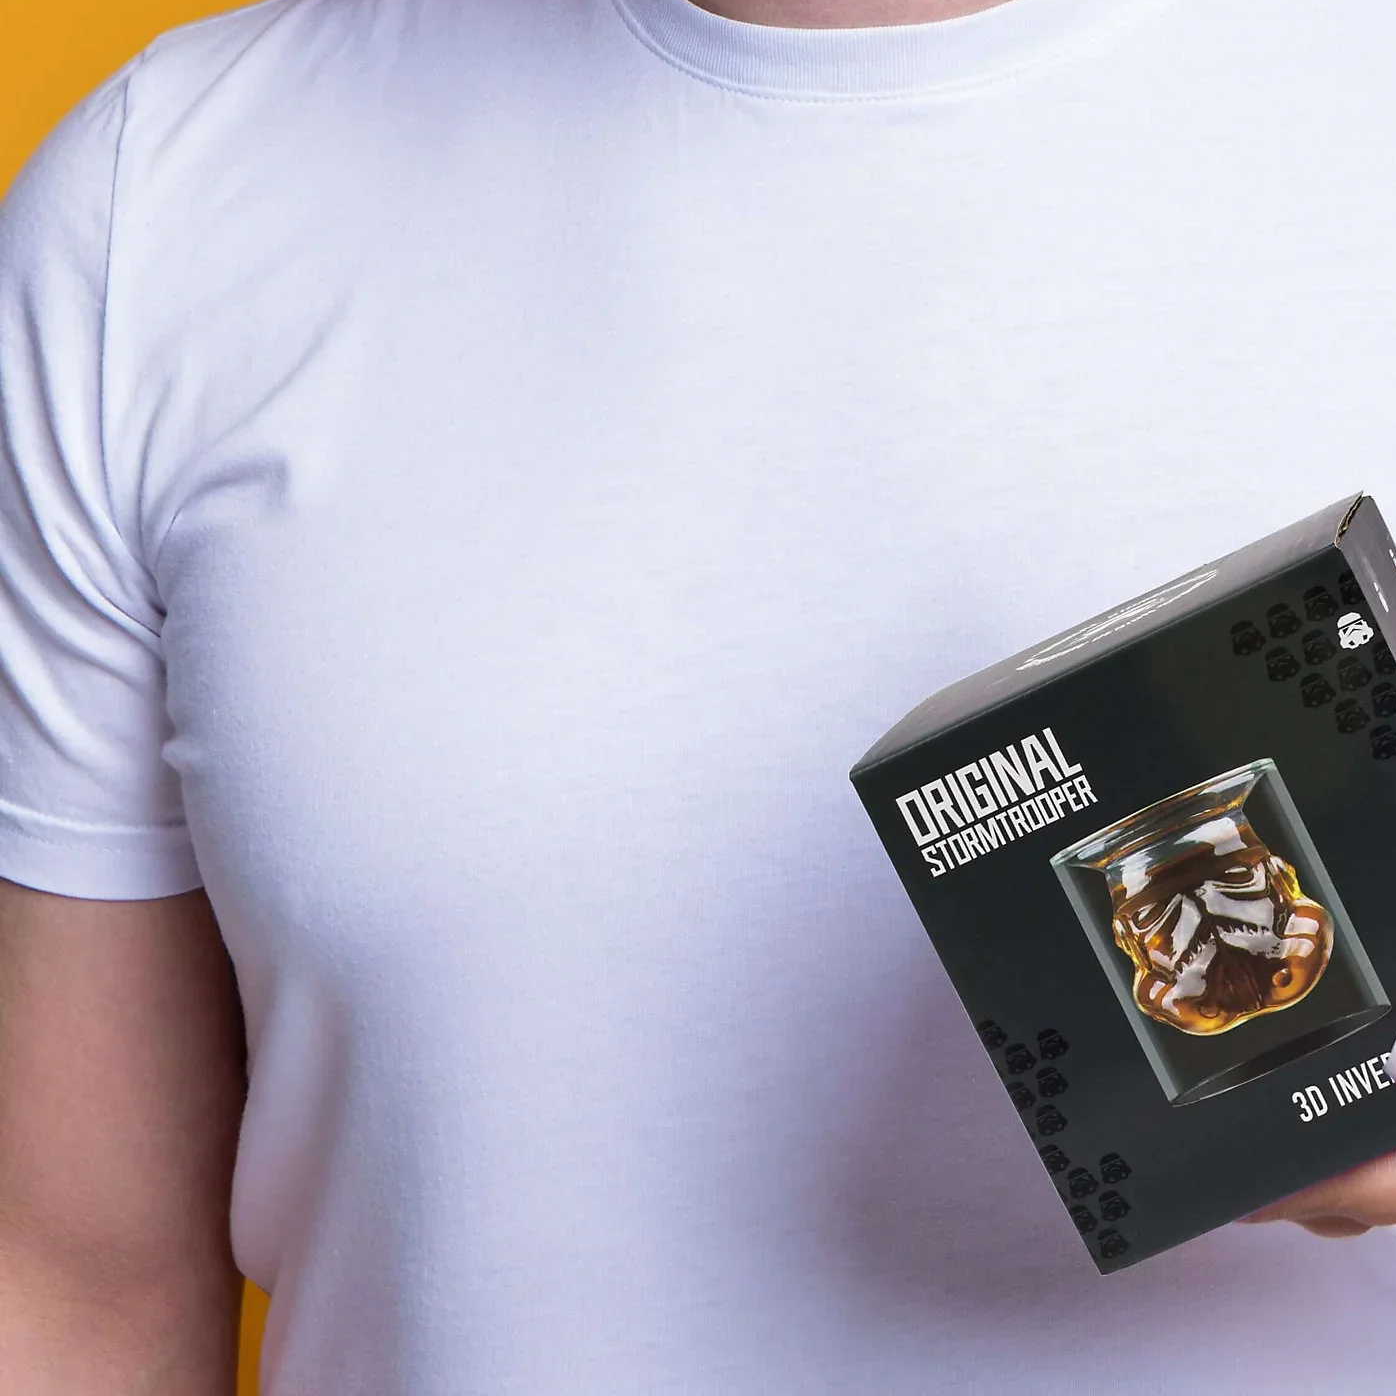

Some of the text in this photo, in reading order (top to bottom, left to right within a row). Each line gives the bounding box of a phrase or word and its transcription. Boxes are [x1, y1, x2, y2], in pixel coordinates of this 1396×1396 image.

[896, 727, 1083, 846] ORIGINAL
[921, 775, 1098, 877] STORMTROOPER
[1292, 1085, 1328, 1122] 3D
[1328, 1052, 1396, 1106] INVE
